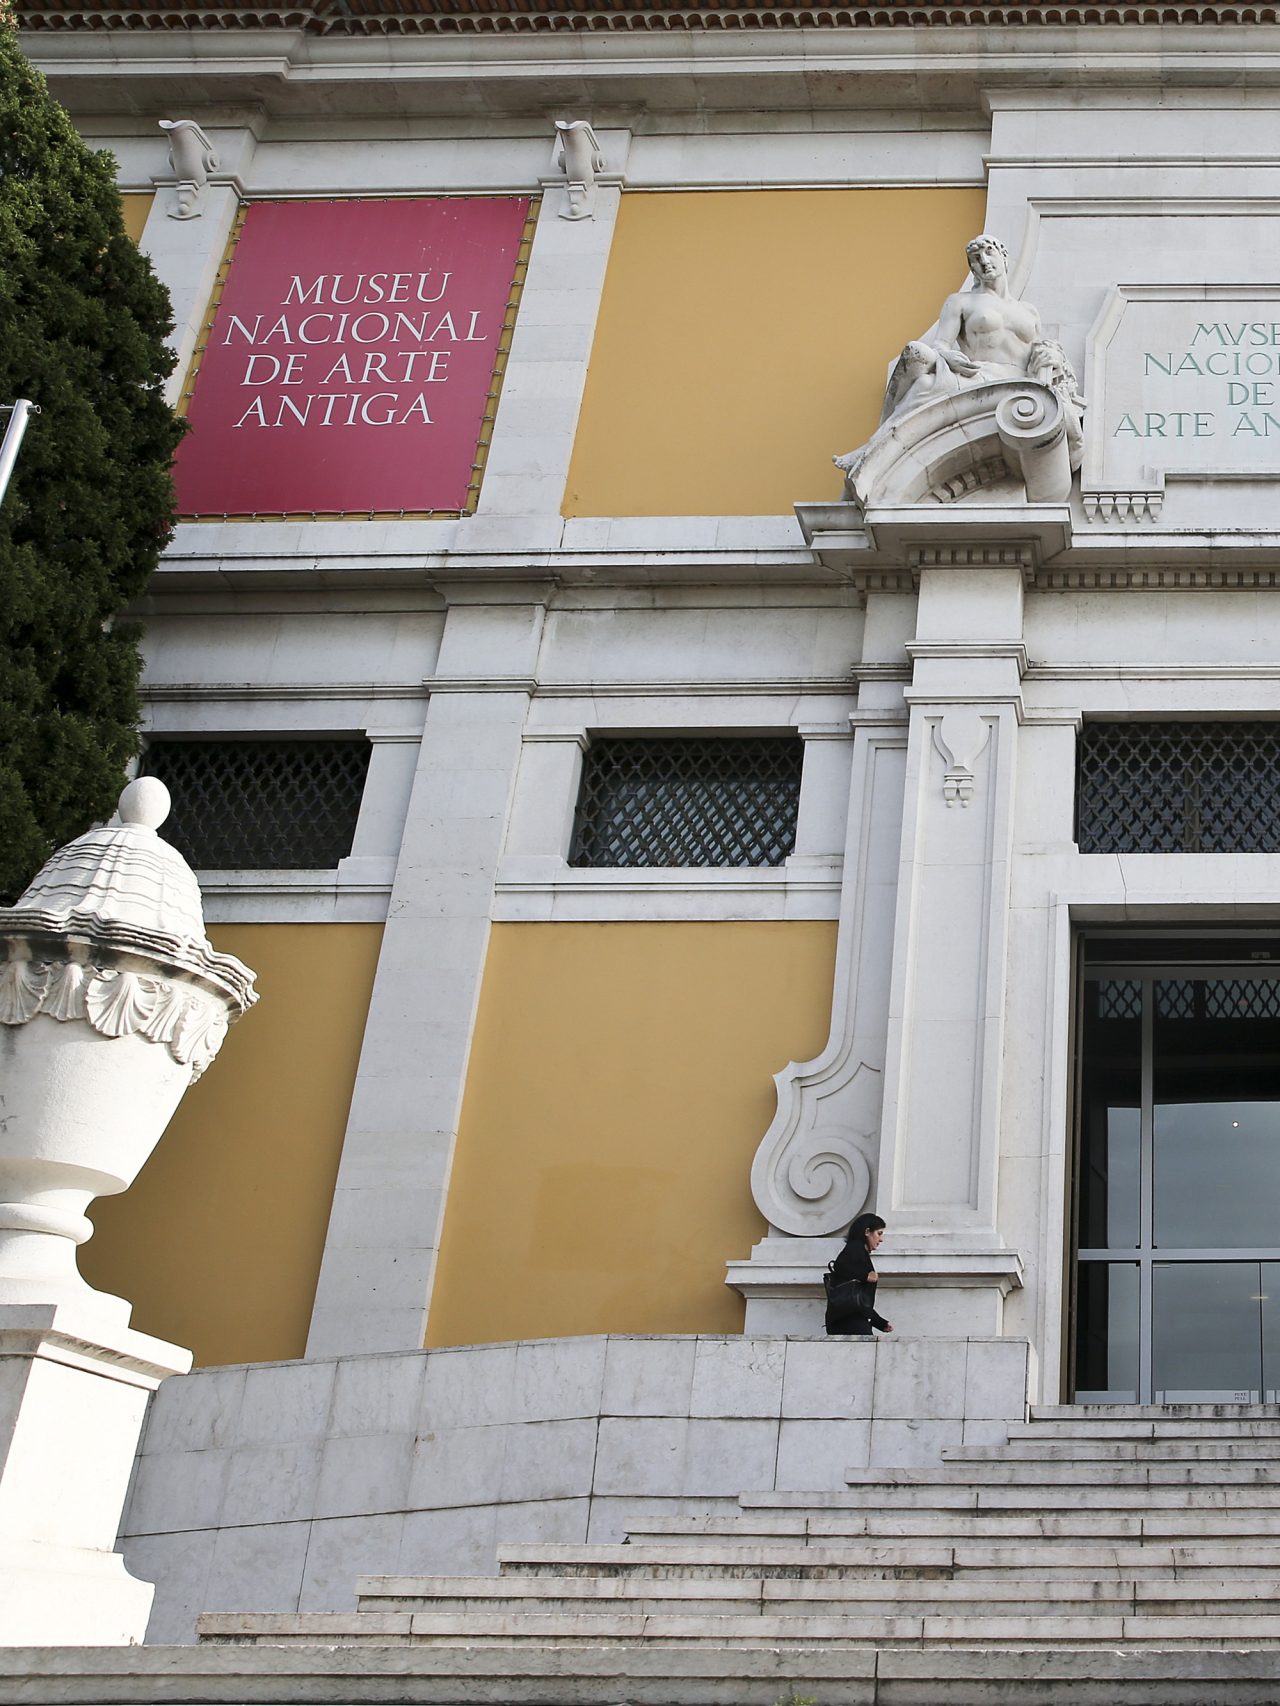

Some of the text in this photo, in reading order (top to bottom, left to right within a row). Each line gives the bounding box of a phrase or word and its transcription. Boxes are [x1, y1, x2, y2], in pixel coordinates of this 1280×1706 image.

[280, 272, 453, 305] MUSEU
[221, 311, 488, 345] NACIONAL
[240, 351, 452, 386] DE ARTE
[232, 392, 435, 428] ANTIGA
[1227, 382, 1275, 405] DE
[1113, 413, 1215, 437] ARTE
